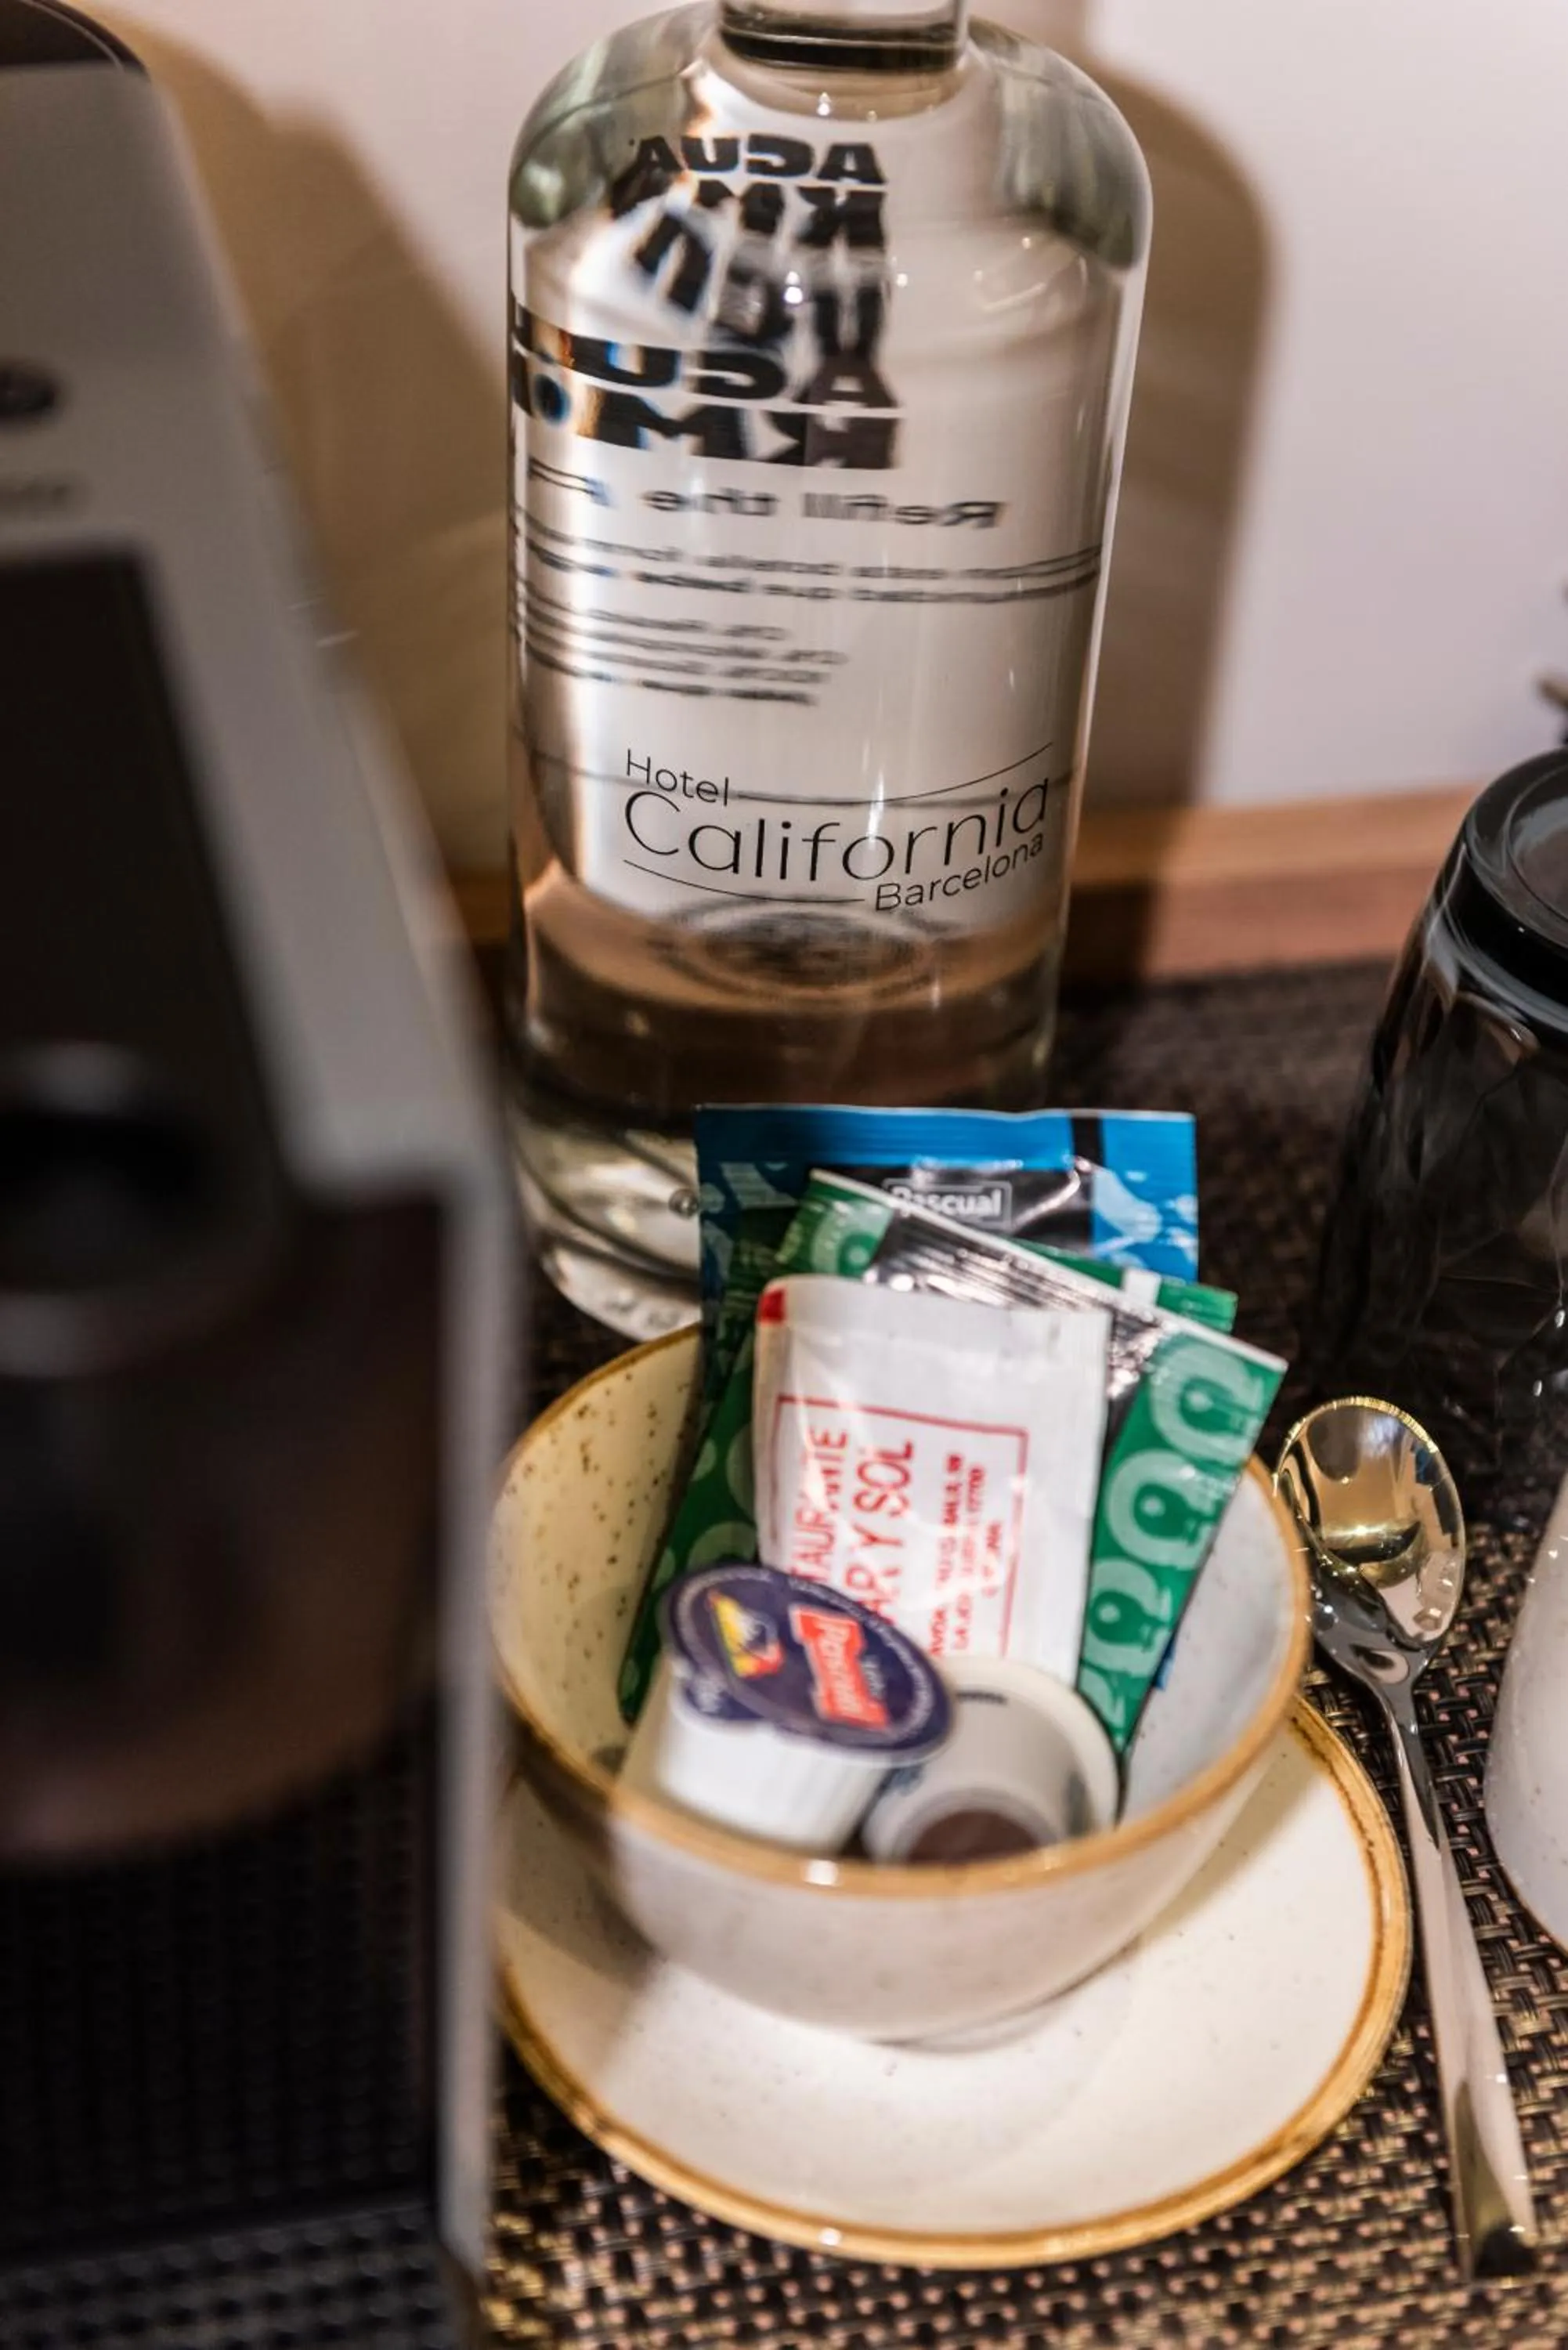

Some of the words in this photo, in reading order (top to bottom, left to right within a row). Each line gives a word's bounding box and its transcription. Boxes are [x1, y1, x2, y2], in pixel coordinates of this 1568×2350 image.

[626, 748, 729, 806] Hotel
[624, 777, 1050, 881] California
[874, 832, 1043, 912] Barcelona
[853, 1441, 914, 1517] SOL
